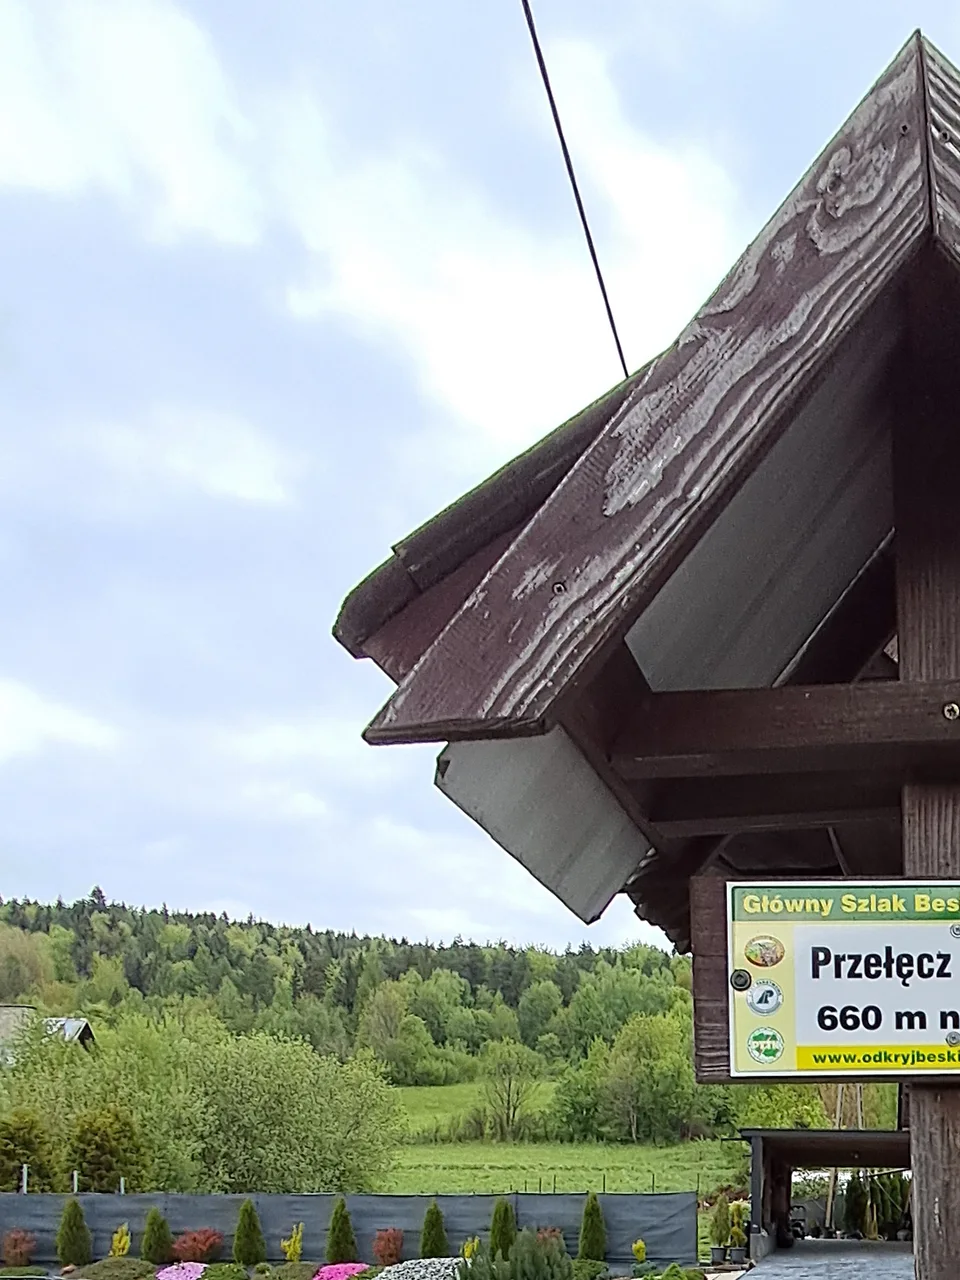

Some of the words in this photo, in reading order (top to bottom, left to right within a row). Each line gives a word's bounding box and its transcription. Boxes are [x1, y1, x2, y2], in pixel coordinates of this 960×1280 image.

[743, 894, 834, 917] Główny
[841, 894, 907, 913] Szlak
[811, 945, 952, 987] Przełęcz
[817, 1005, 882, 1031] 660
[895, 1009, 927, 1030] m
